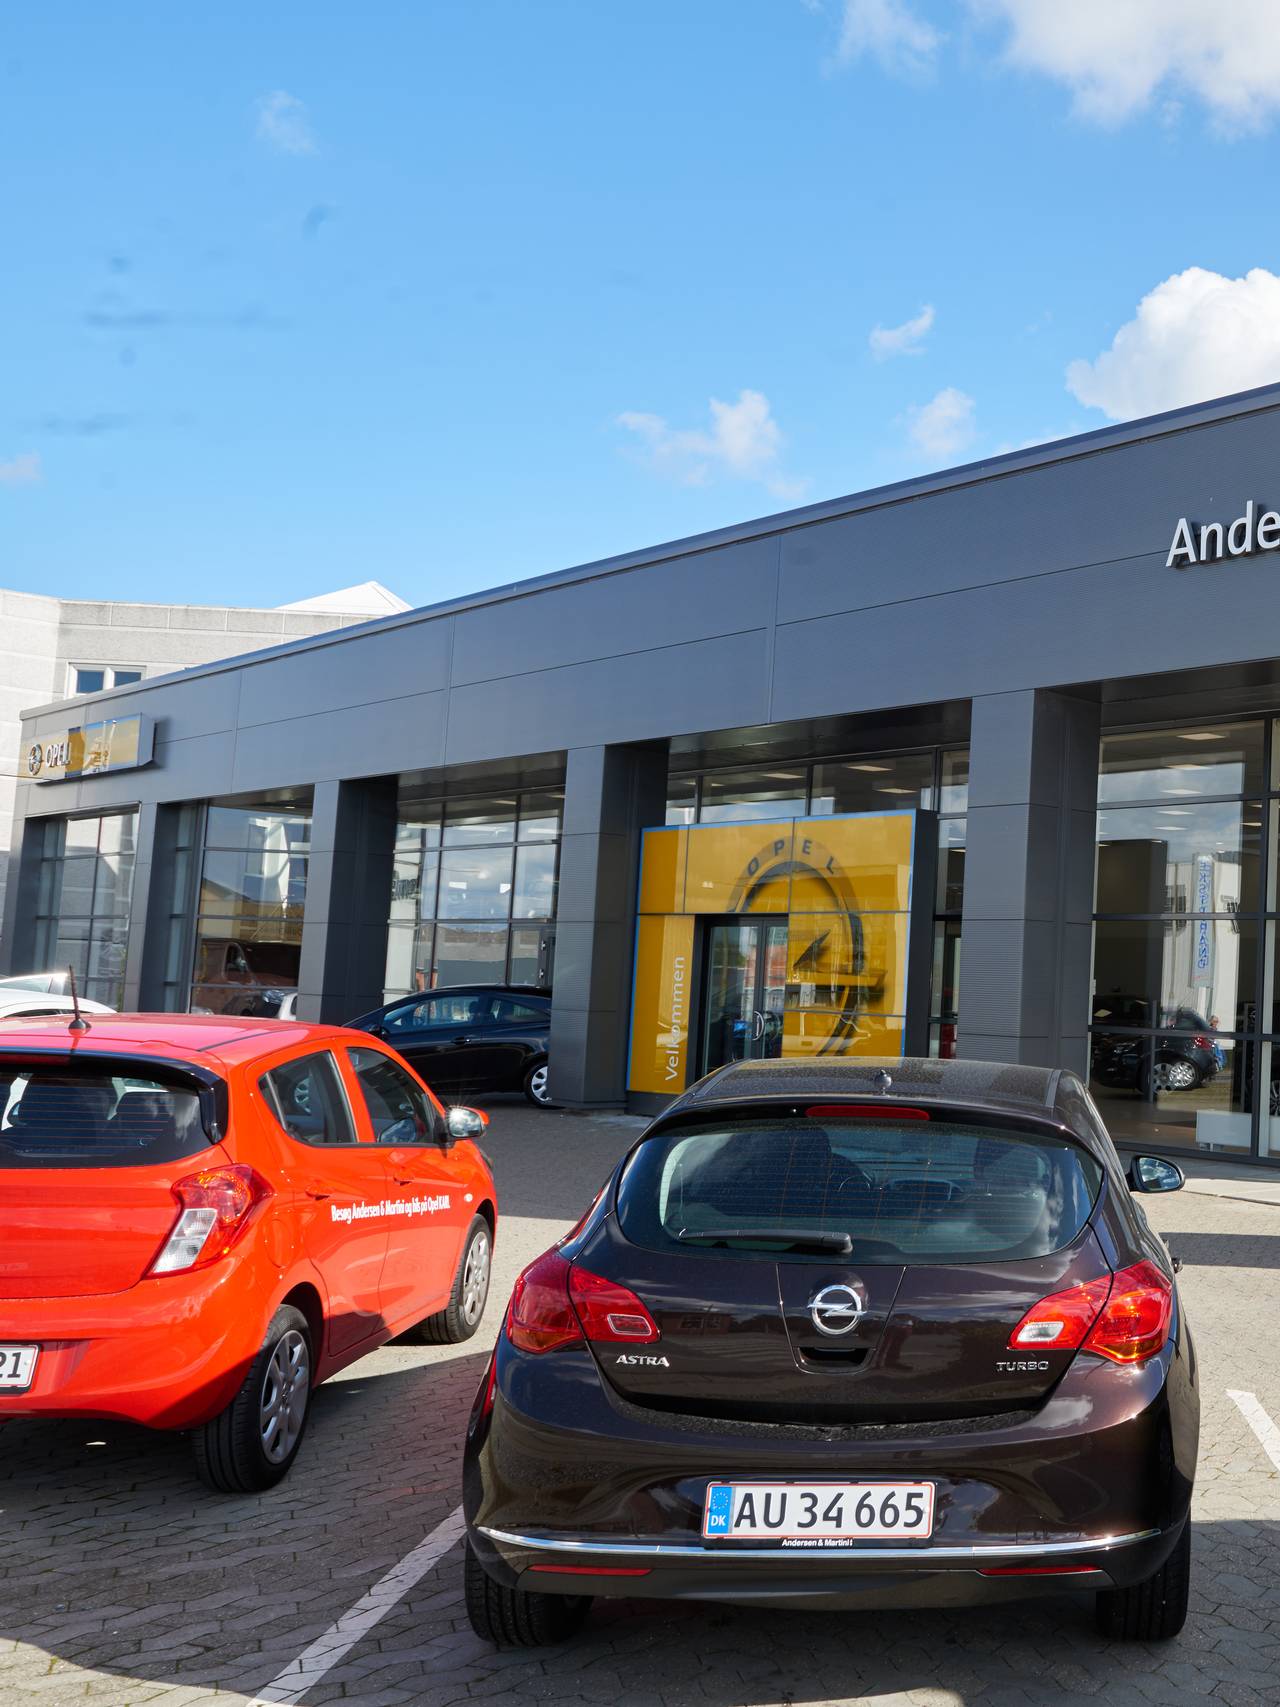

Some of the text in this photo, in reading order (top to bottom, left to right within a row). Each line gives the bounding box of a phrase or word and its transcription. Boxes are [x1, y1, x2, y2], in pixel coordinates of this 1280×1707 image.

[46, 742, 71, 768] OPEL
[748, 839, 834, 875] OPEL
[664, 956, 685, 1081] Velkommen
[331, 1205, 352, 1224] Besøg
[352, 1201, 380, 1219] Andersen
[385, 1200, 405, 1216] Martini
[405, 1202, 412, 1217] og
[412, 1197, 420, 1213] hils
[420, 1196, 427, 1216] på
[427, 1195, 439, 1214] Opel
[439, 1194, 451, 1209] KARL
[615, 1354, 670, 1367] ASTRA
[996, 1361, 1049, 1371] TURBO
[710, 1515, 726, 1527] DK
[734, 1490, 924, 1529] AU 34 665
[782, 1538, 817, 1547] Andersen
[817, 1538, 824, 1547] &
